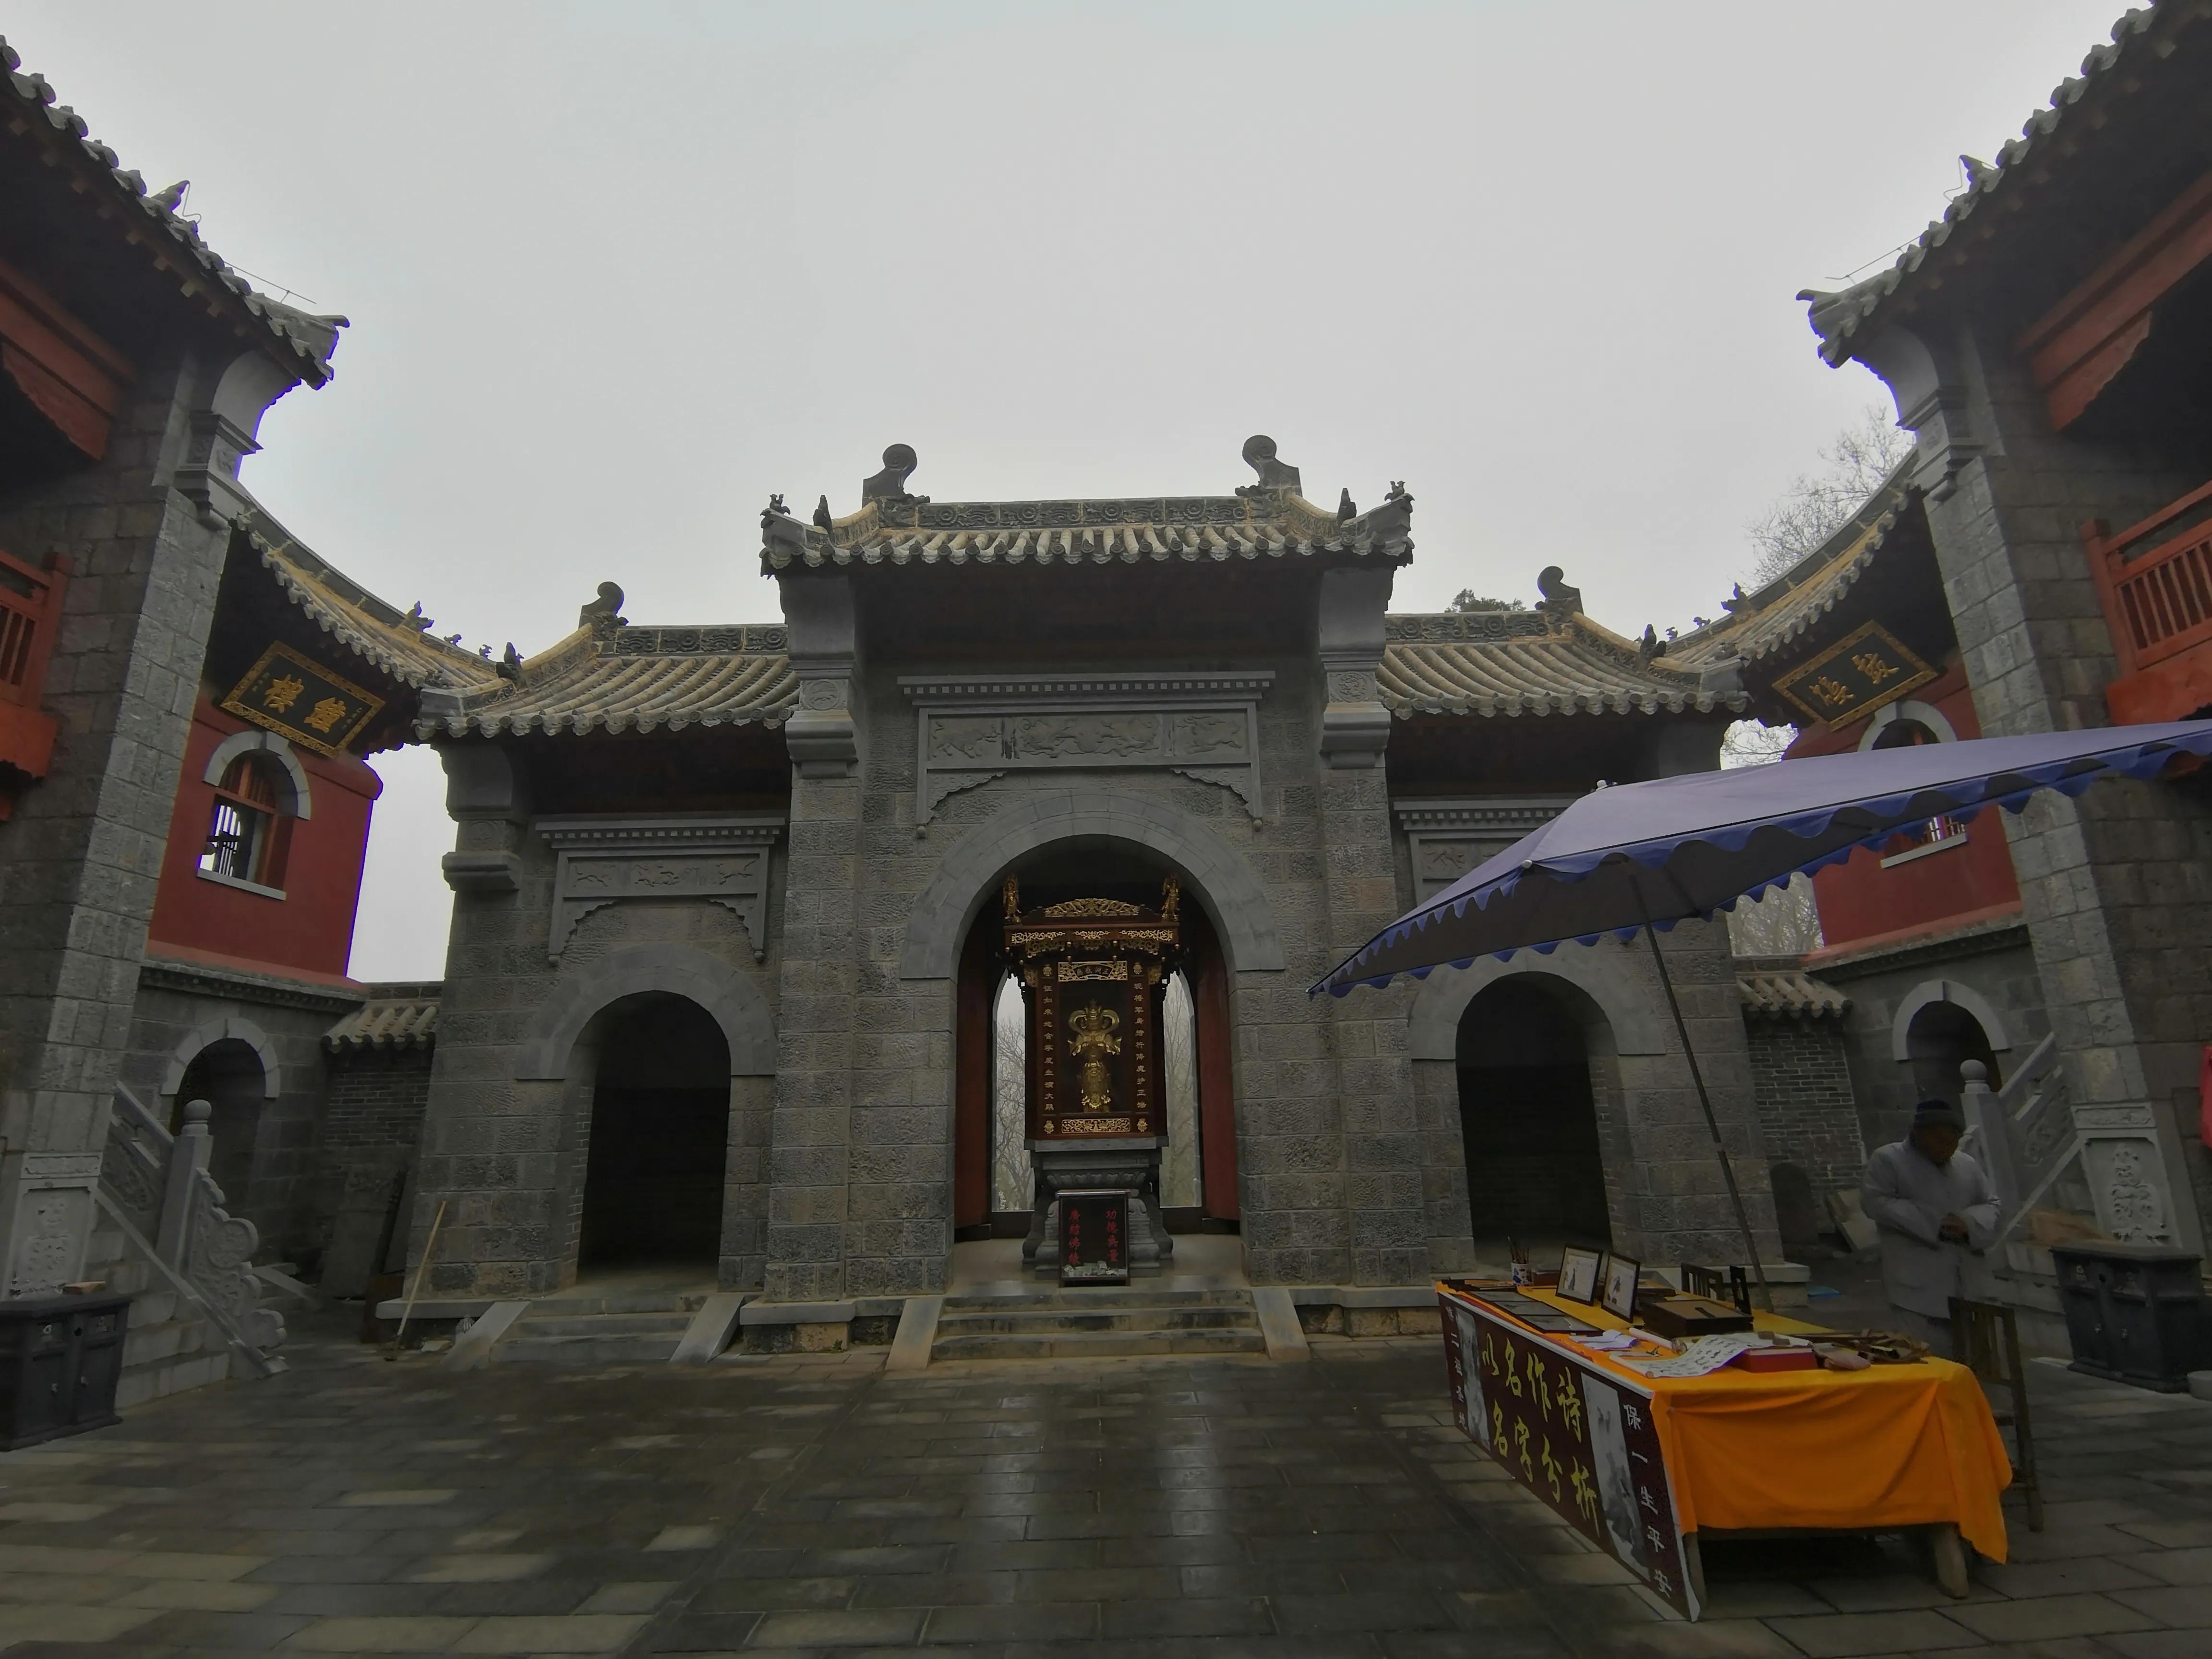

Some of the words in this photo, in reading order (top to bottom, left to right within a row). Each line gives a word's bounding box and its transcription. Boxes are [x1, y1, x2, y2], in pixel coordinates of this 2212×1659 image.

[1493, 1398, 1600, 1538] 名字分析
[1623, 1404, 1672, 1599] 保一生平安
